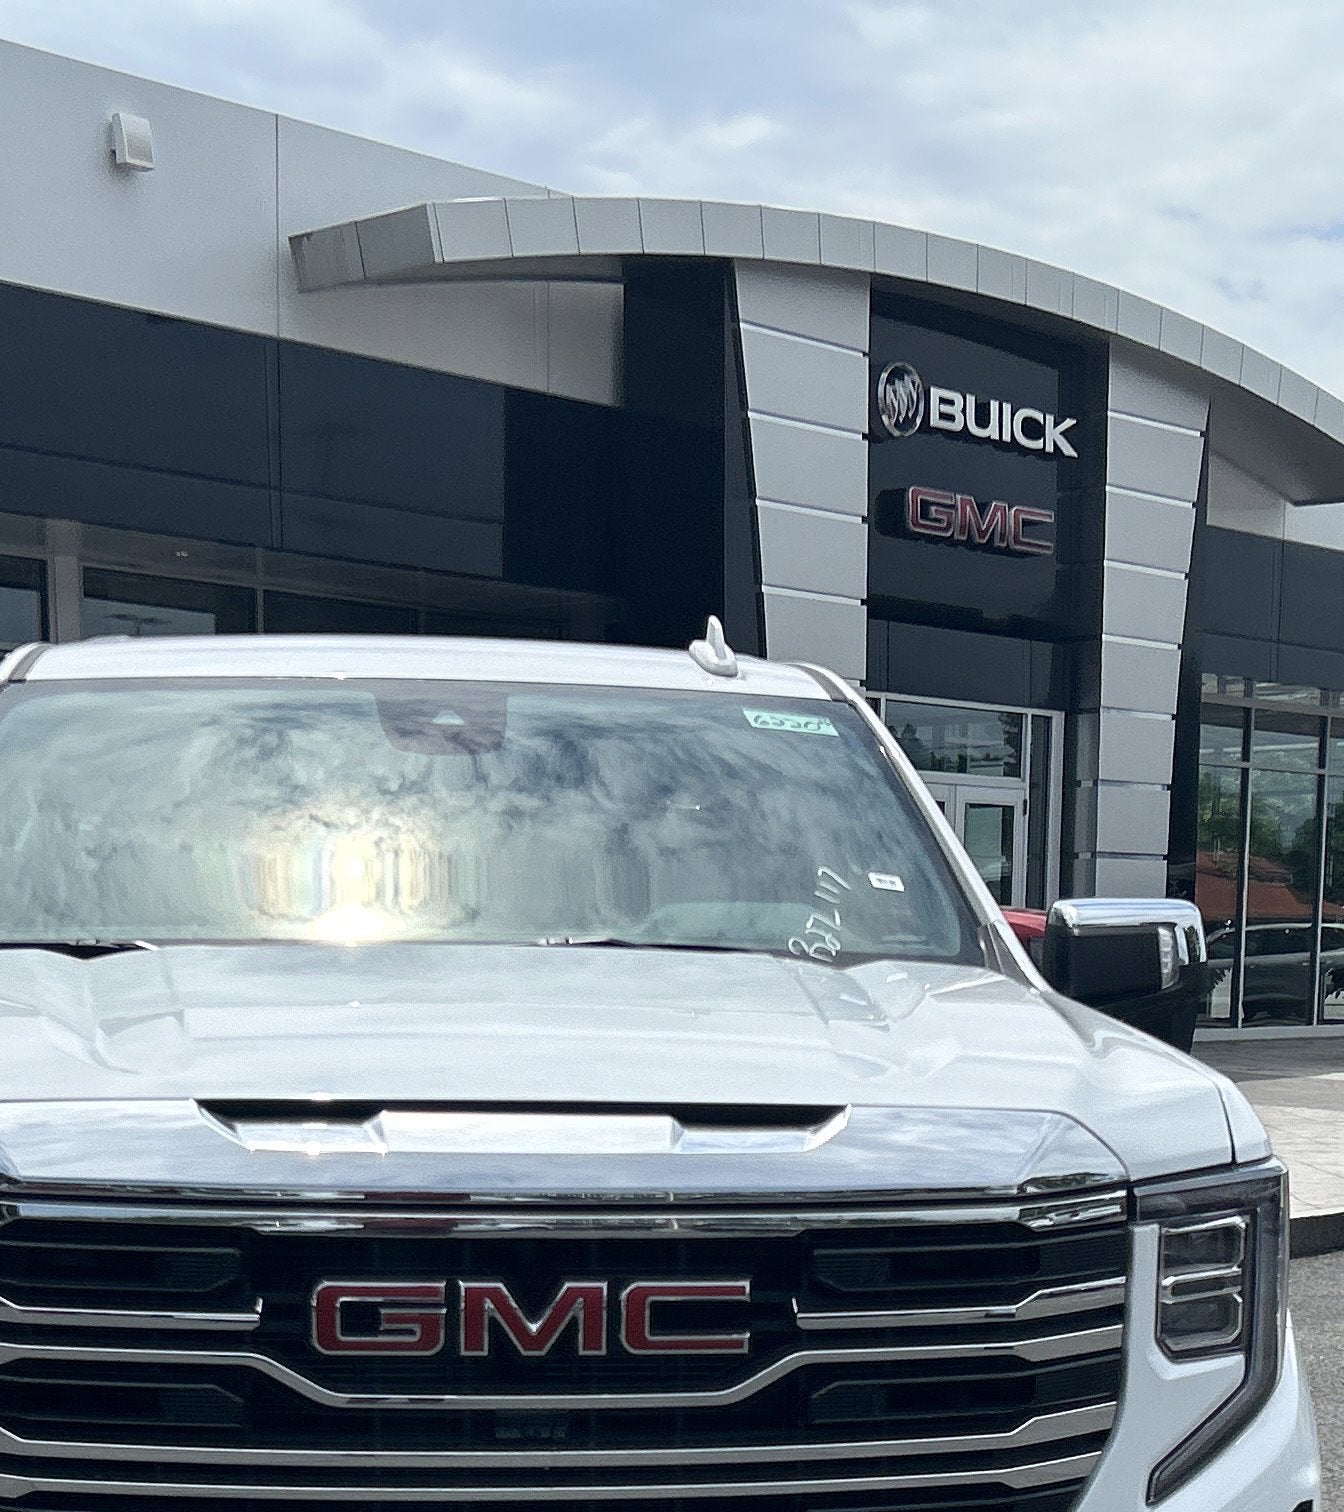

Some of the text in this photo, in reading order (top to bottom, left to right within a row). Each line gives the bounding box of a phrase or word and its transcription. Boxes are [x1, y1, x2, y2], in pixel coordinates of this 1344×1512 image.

[929, 385, 1079, 458] BUICK
[908, 485, 1055, 555] GMC
[312, 1280, 751, 1356] GMC
